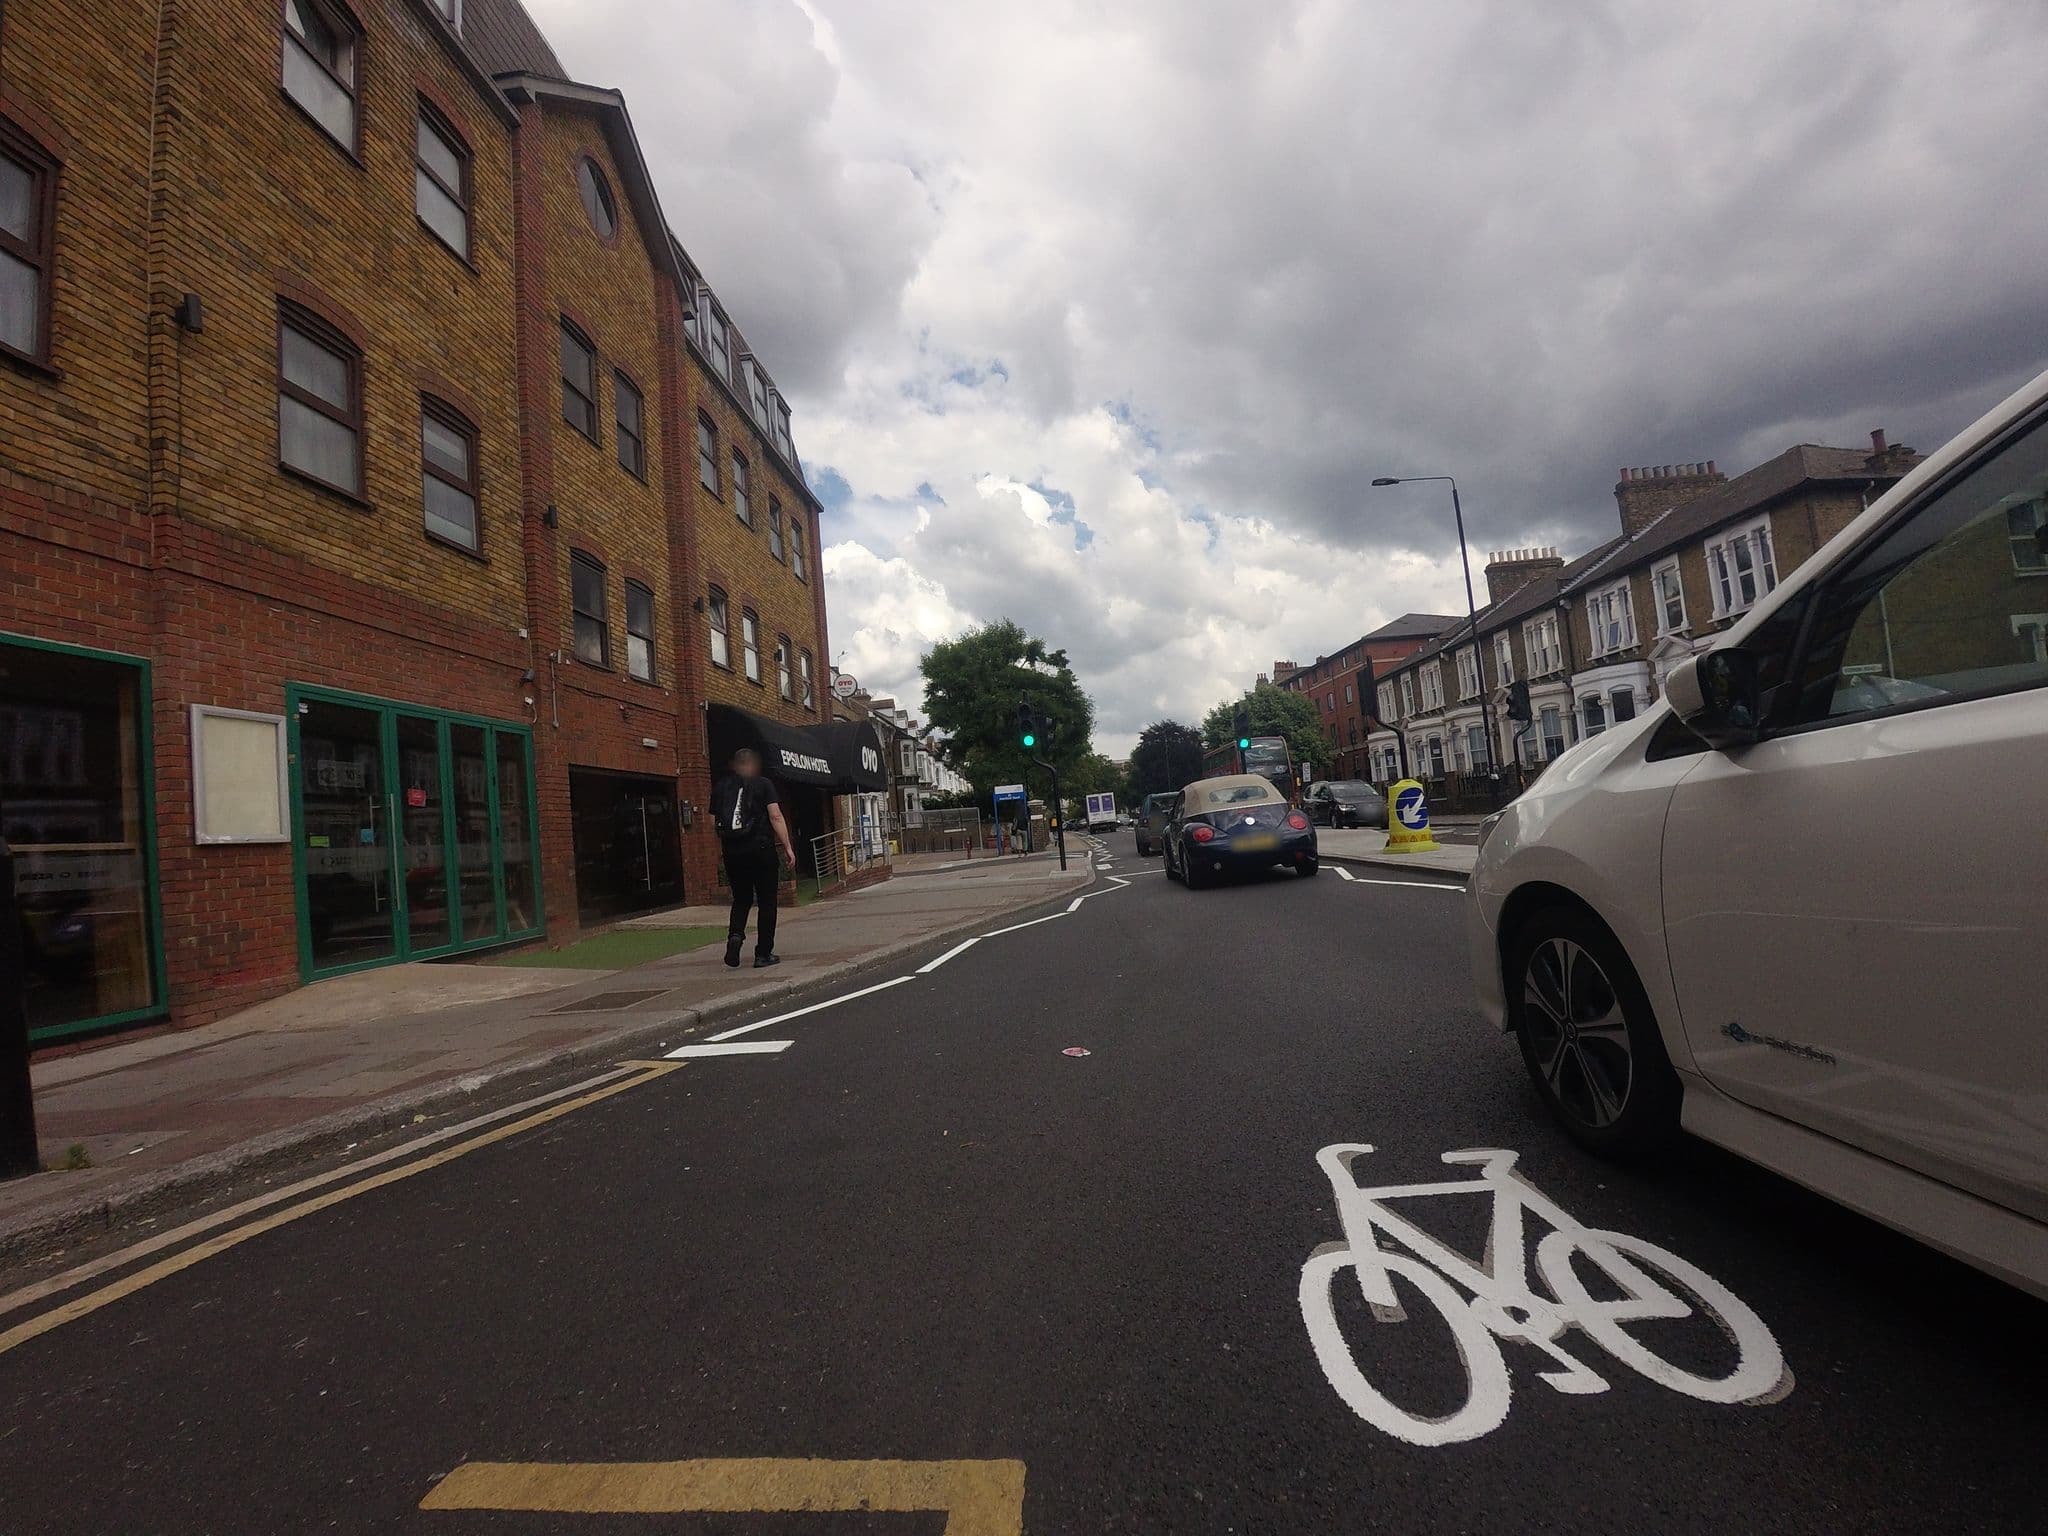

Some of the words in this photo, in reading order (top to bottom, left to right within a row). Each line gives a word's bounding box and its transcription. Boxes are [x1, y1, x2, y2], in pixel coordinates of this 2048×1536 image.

[780, 749, 811, 770] EPSILON
[810, 757, 831, 774] HOTEL
[861, 745, 878, 773] OYO
